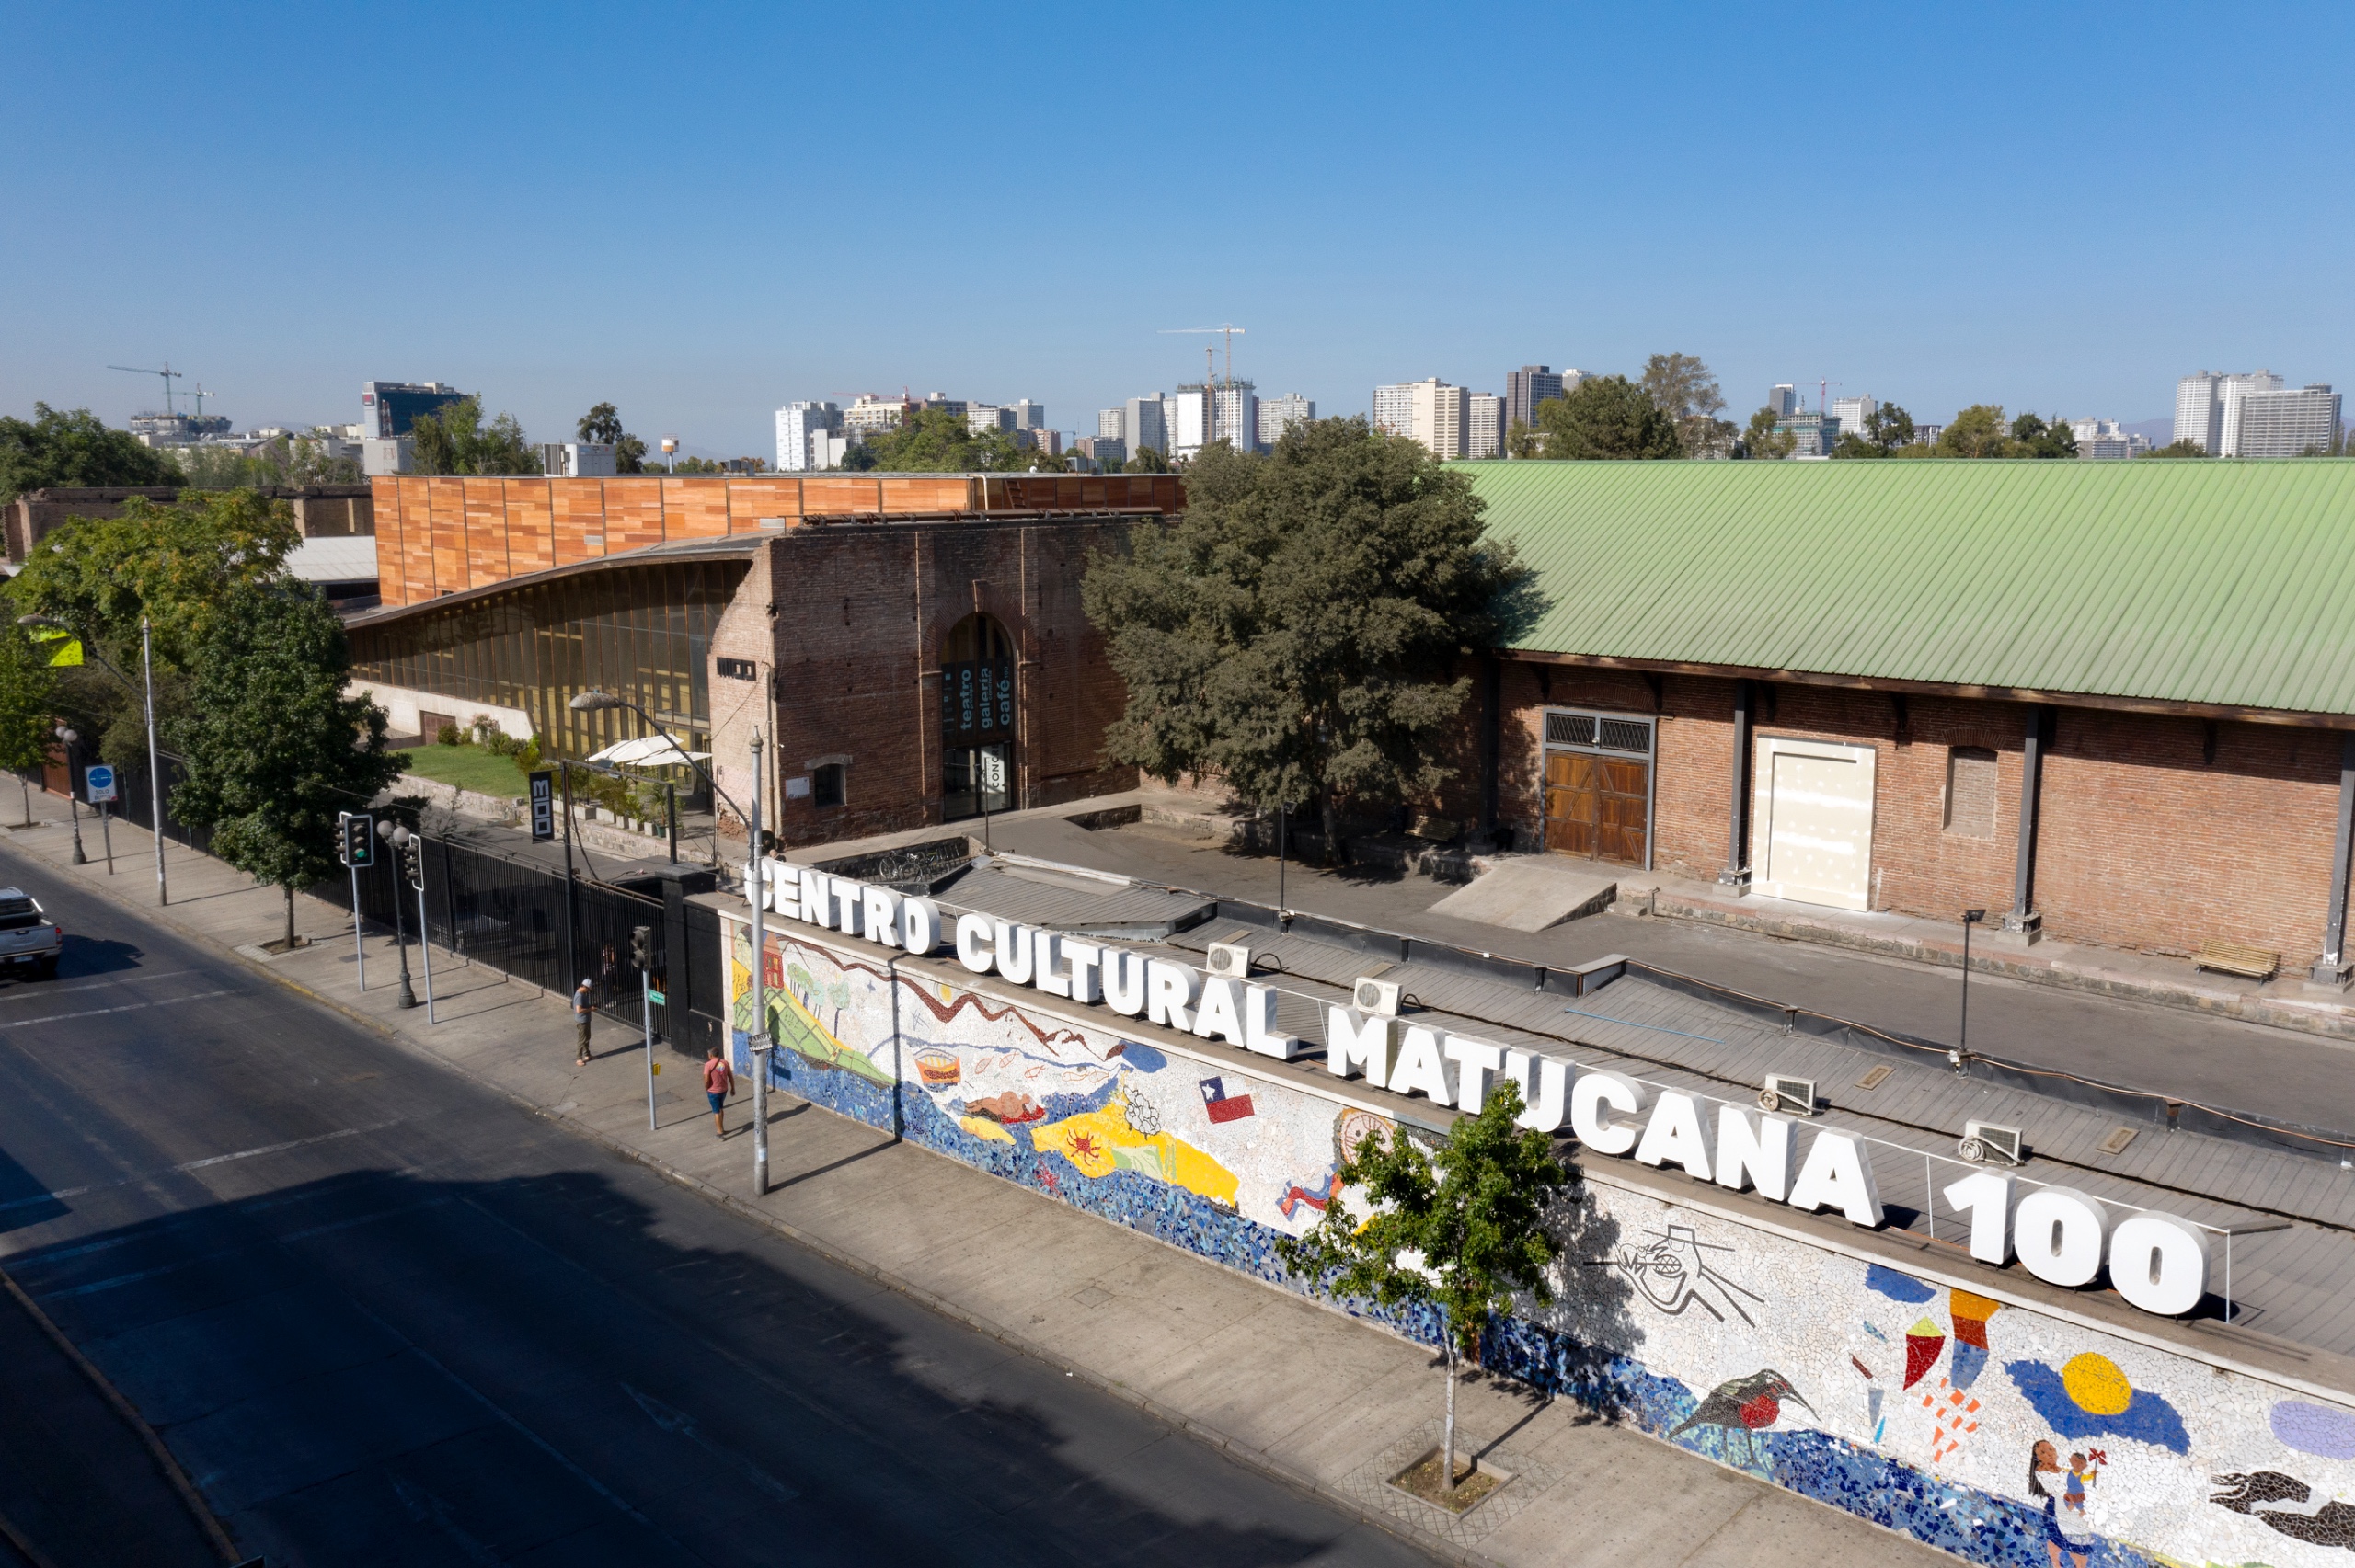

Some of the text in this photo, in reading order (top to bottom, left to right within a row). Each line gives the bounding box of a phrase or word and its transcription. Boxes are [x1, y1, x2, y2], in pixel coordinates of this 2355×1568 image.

[959, 670, 971, 730] teatro
[979, 668, 993, 729] galería
[996, 679, 1010, 726] café
[743, 855, 2208, 1315] CENTRO CULTURAL MATUCANA 100
